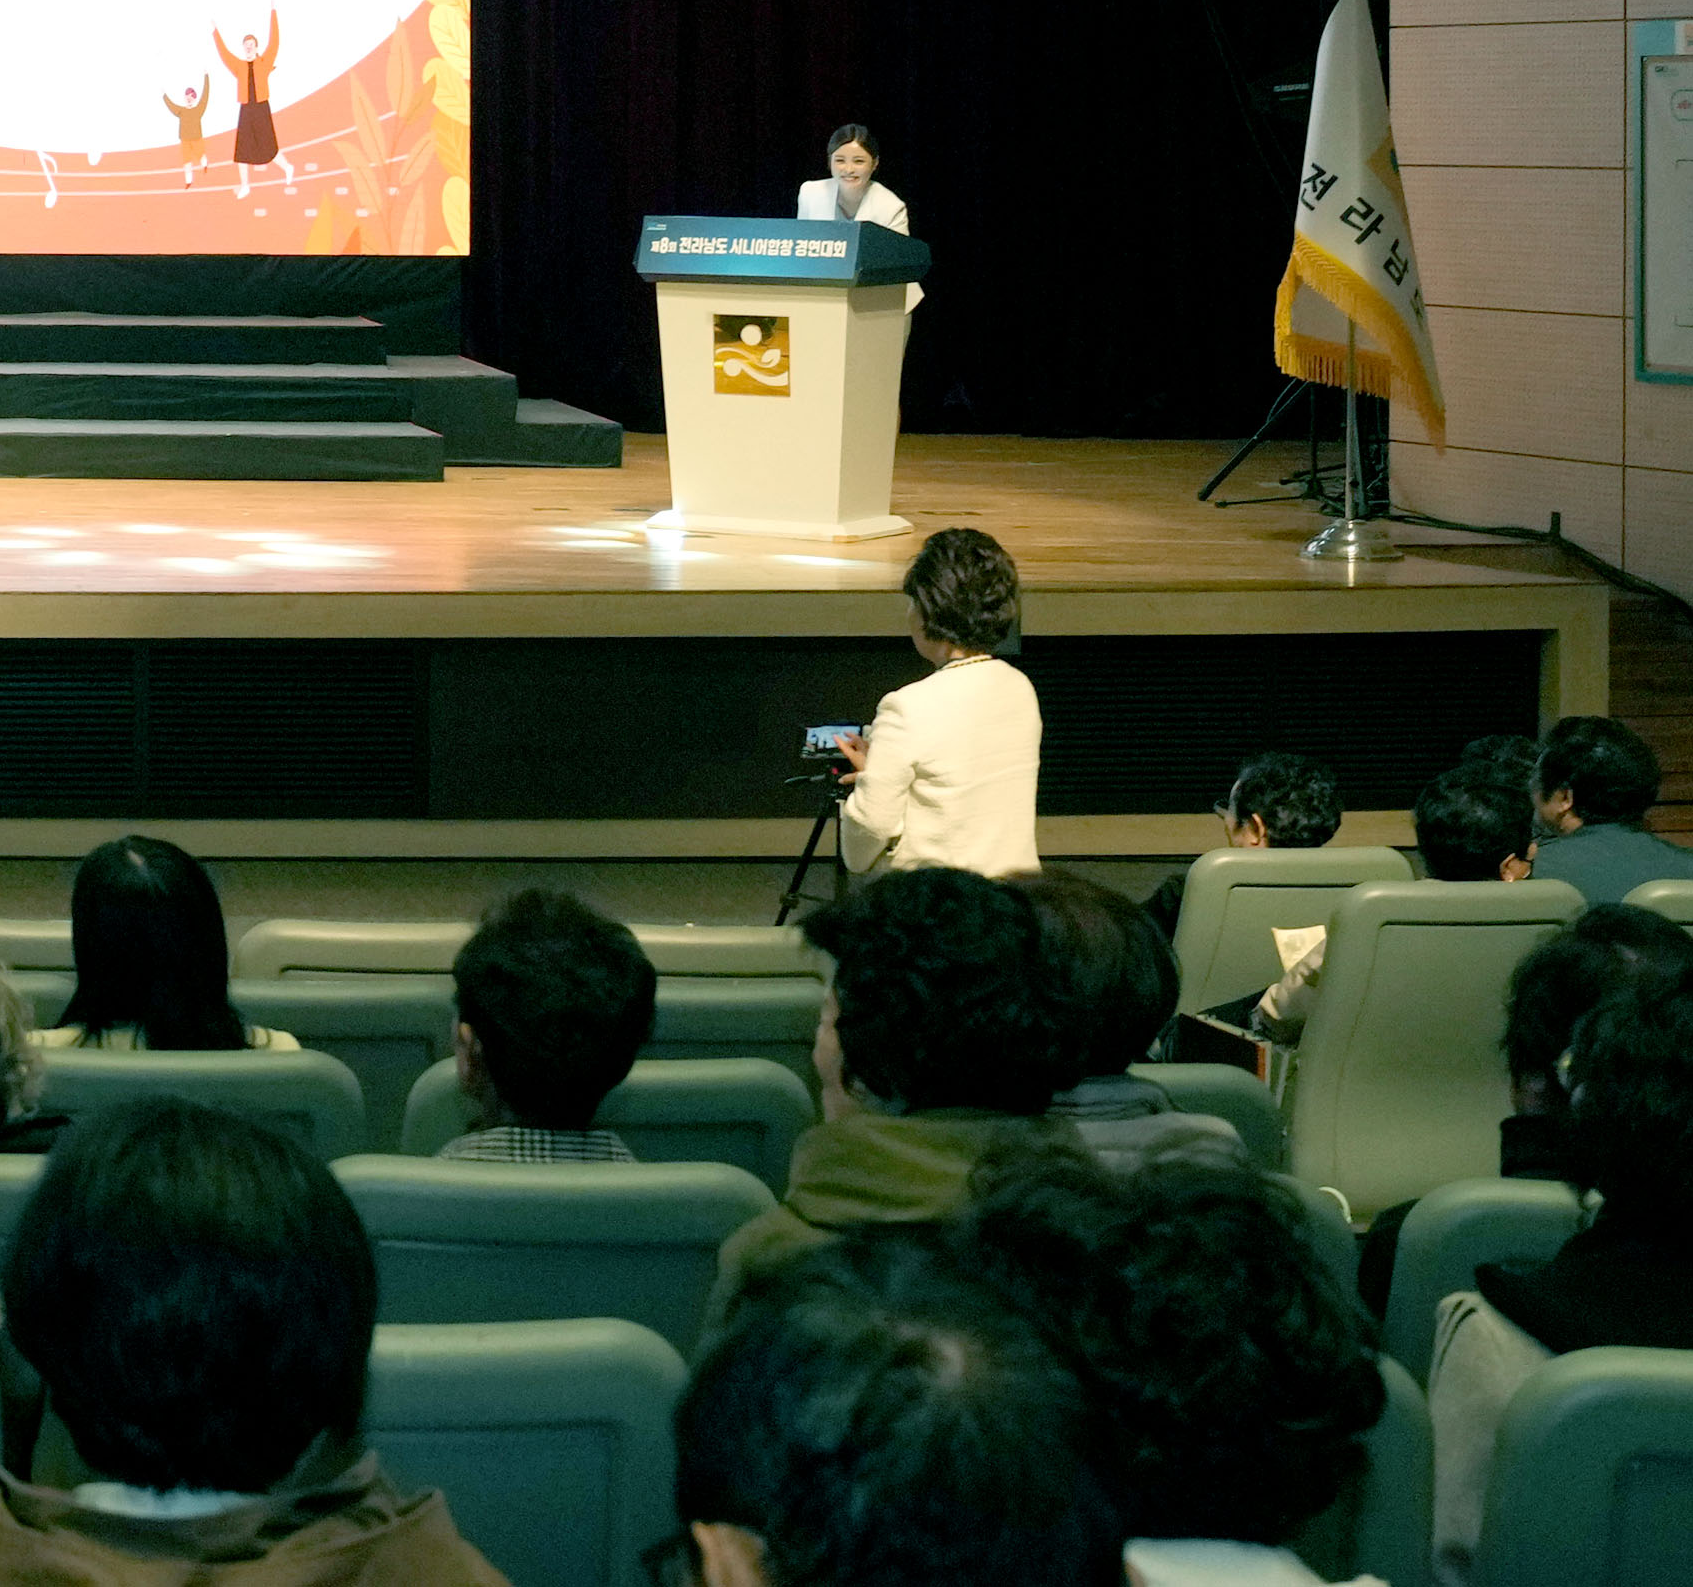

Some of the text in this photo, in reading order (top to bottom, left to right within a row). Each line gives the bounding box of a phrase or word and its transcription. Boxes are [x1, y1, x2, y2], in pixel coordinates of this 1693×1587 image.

[679, 236, 729, 255] 전라남도
[729, 237, 794, 257] 시니어합창
[795, 239, 848, 259] 경연대회
